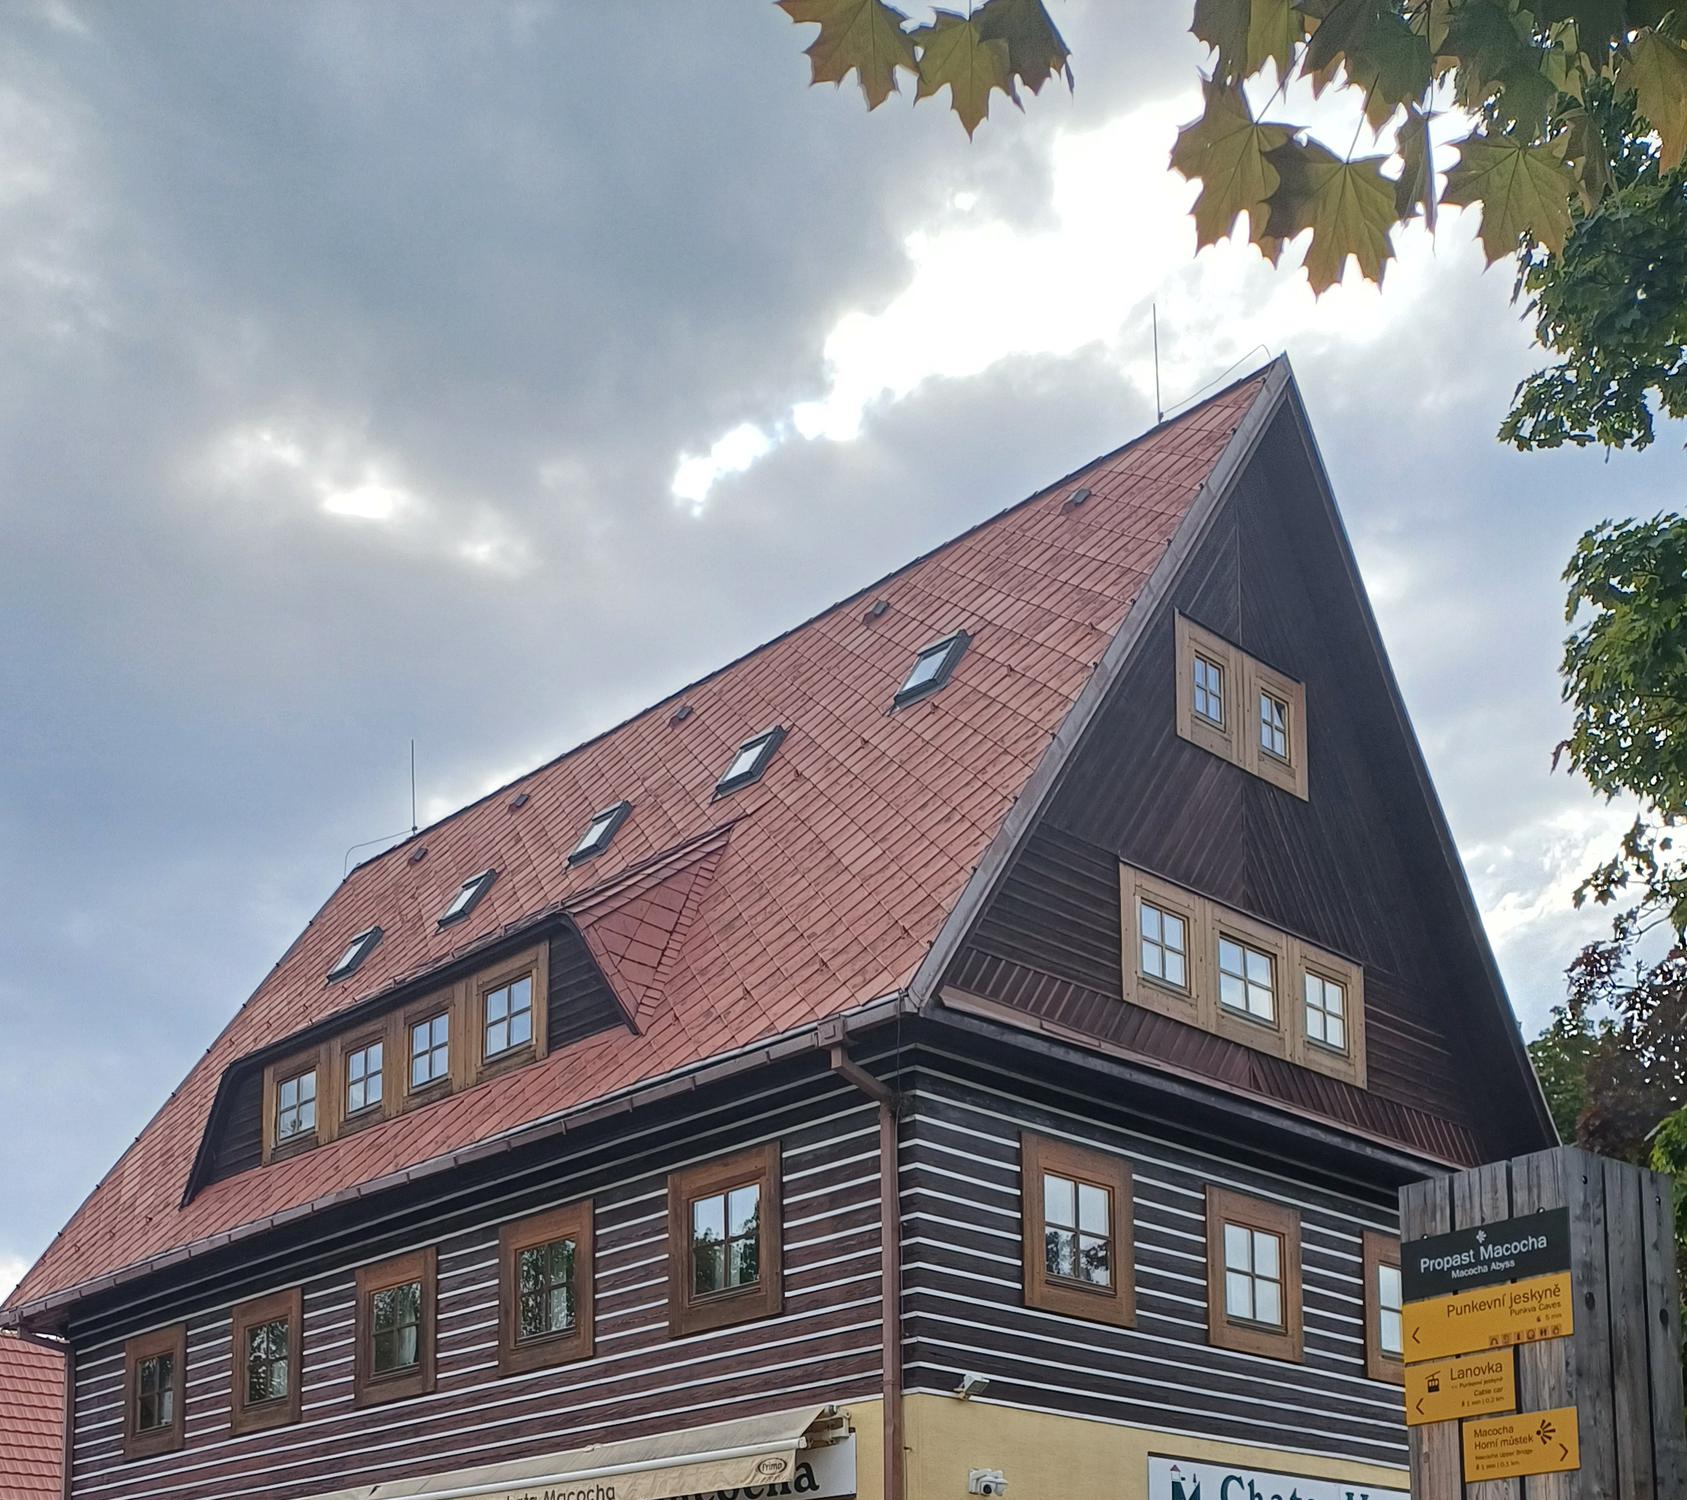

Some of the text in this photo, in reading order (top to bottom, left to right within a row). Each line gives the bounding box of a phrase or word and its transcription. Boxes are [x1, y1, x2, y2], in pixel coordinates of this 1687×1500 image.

[1420, 1235, 1548, 1274] Propast Macocha
[1451, 1259, 1516, 1279] Macocha Abyss
[1447, 1283, 1561, 1318] Punkevní jeskyně
[1450, 1361, 1503, 1381] Lanovka
[1474, 1425, 1514, 1438] Macocha
